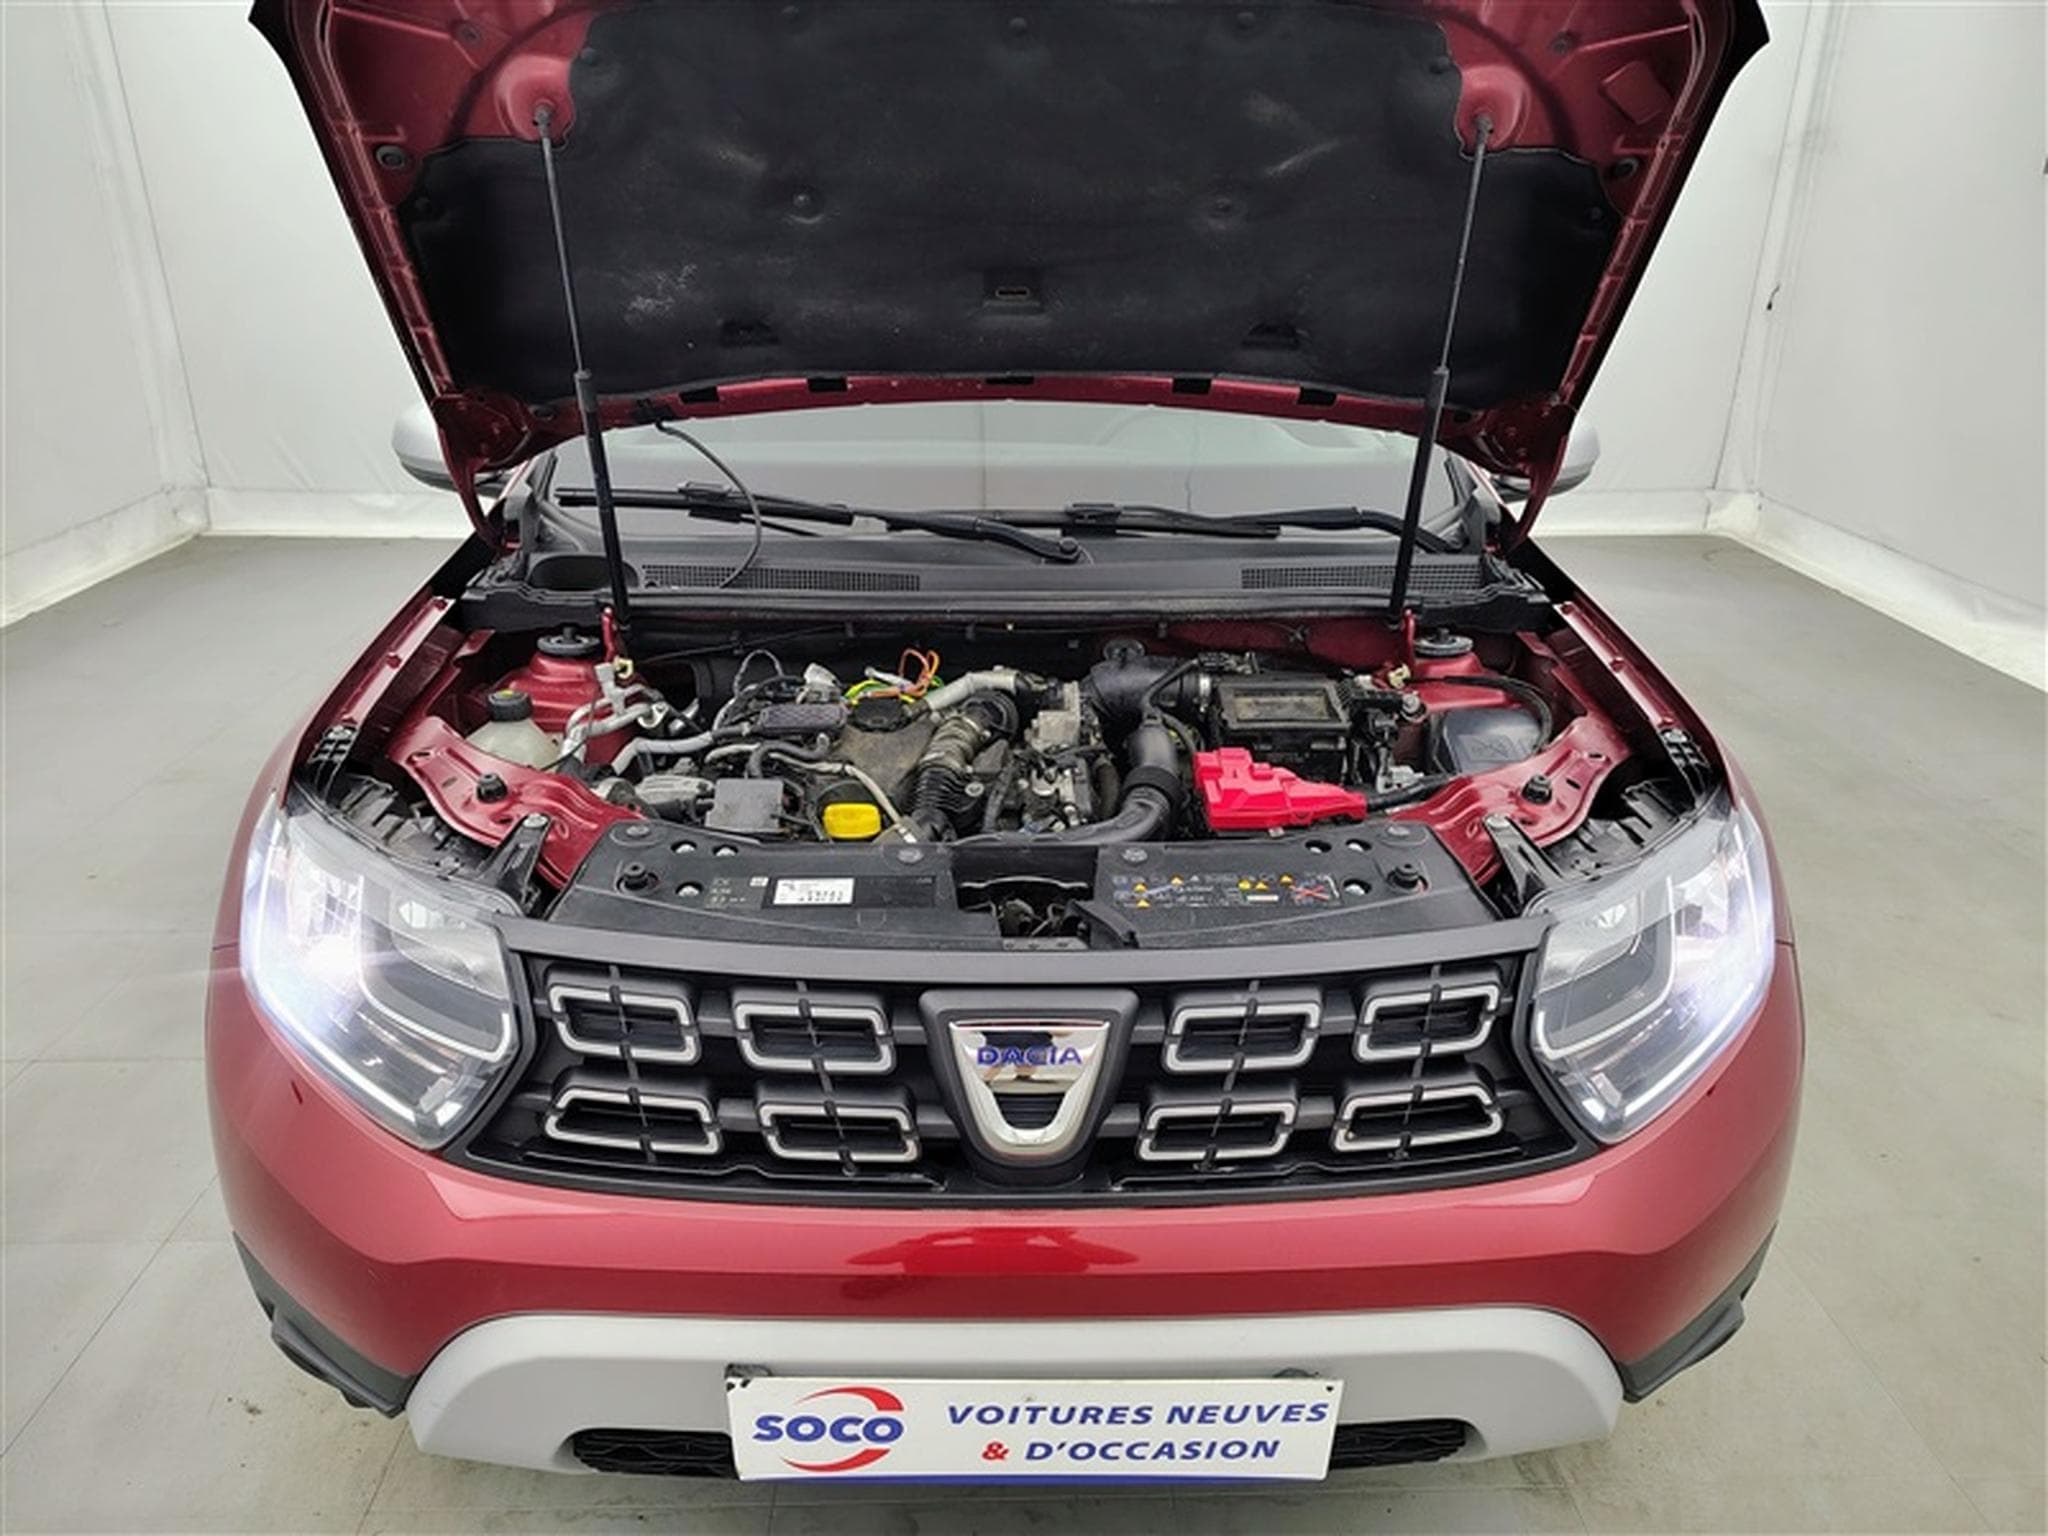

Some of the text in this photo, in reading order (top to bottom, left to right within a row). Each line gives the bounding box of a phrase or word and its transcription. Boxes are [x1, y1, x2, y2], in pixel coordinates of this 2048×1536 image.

[977, 1046, 1082, 1065] DACIA
[948, 1403, 1329, 1425] VOITURES NEUVES
[753, 1415, 904, 1443] SOCO
[981, 1440, 1280, 1461] & D'OCCASION
